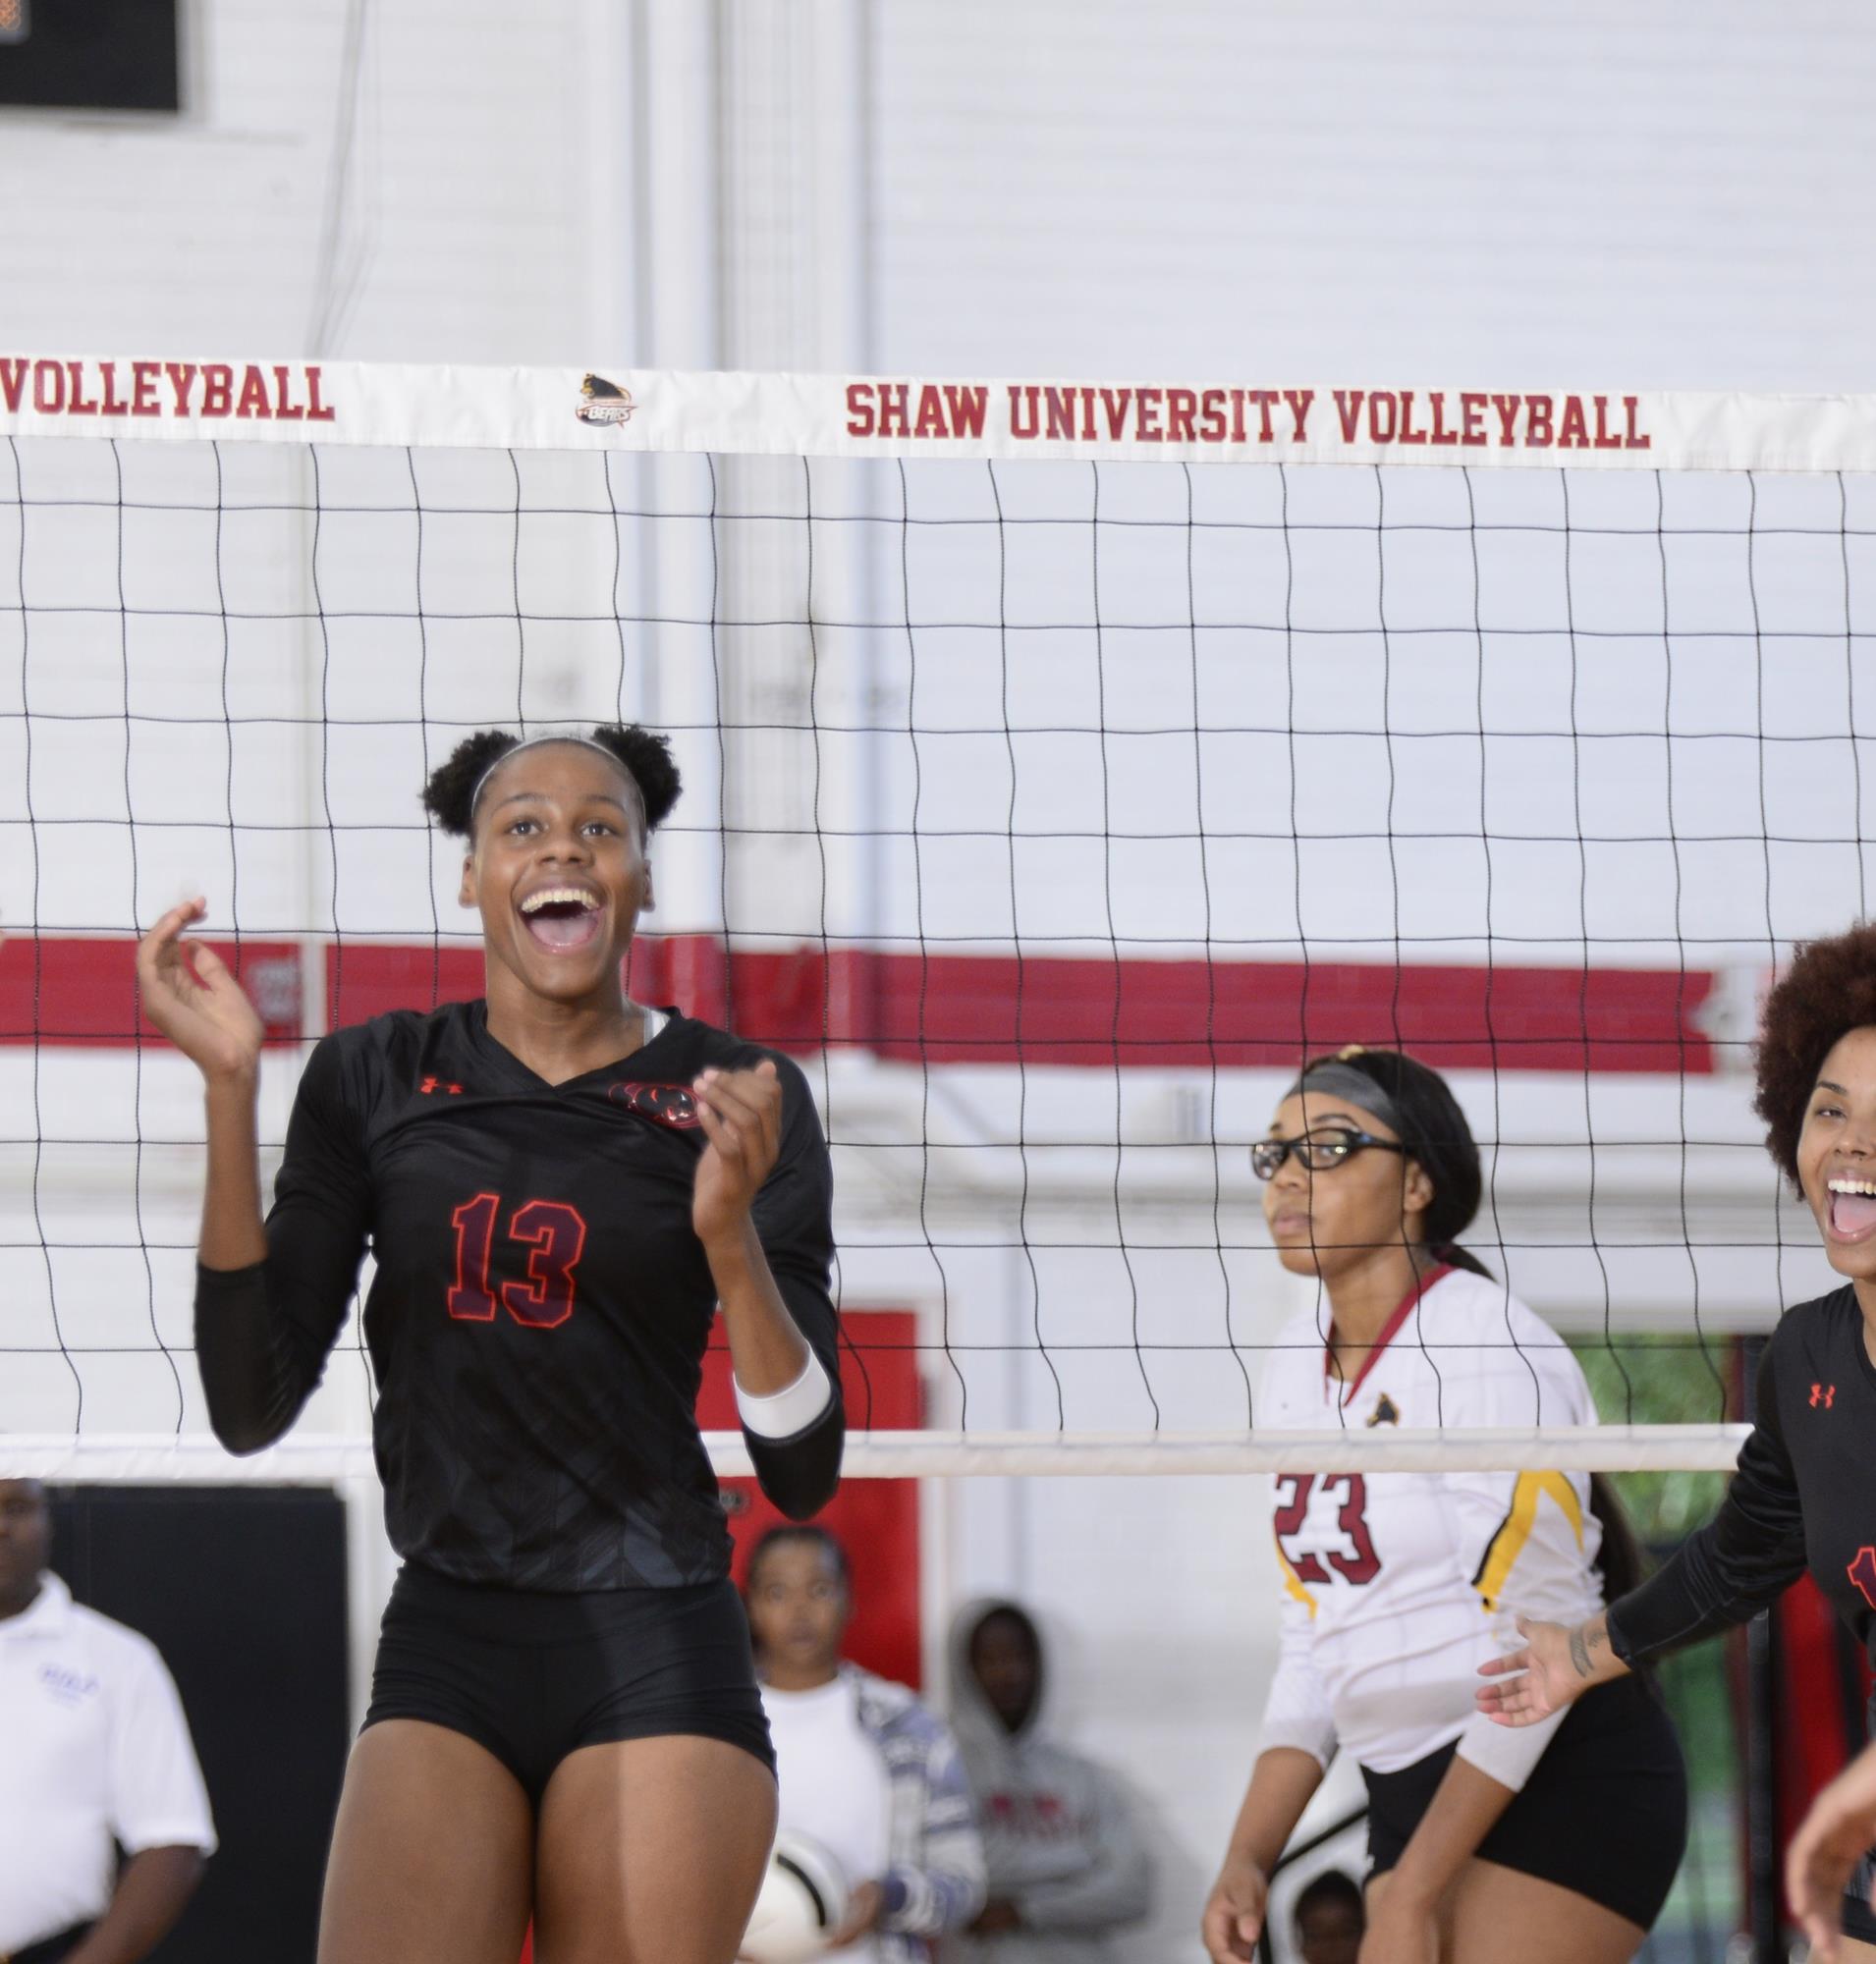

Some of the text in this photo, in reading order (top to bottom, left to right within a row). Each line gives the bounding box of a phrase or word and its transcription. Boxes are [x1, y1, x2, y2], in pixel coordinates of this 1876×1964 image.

[0, 357, 335, 421] VOLLEYBALL
[846, 383, 1652, 449] SHAW UNIVERSITY VOLLEYBALL
[447, 1192, 586, 1329] 13
[1274, 1473, 1382, 1586] 23
